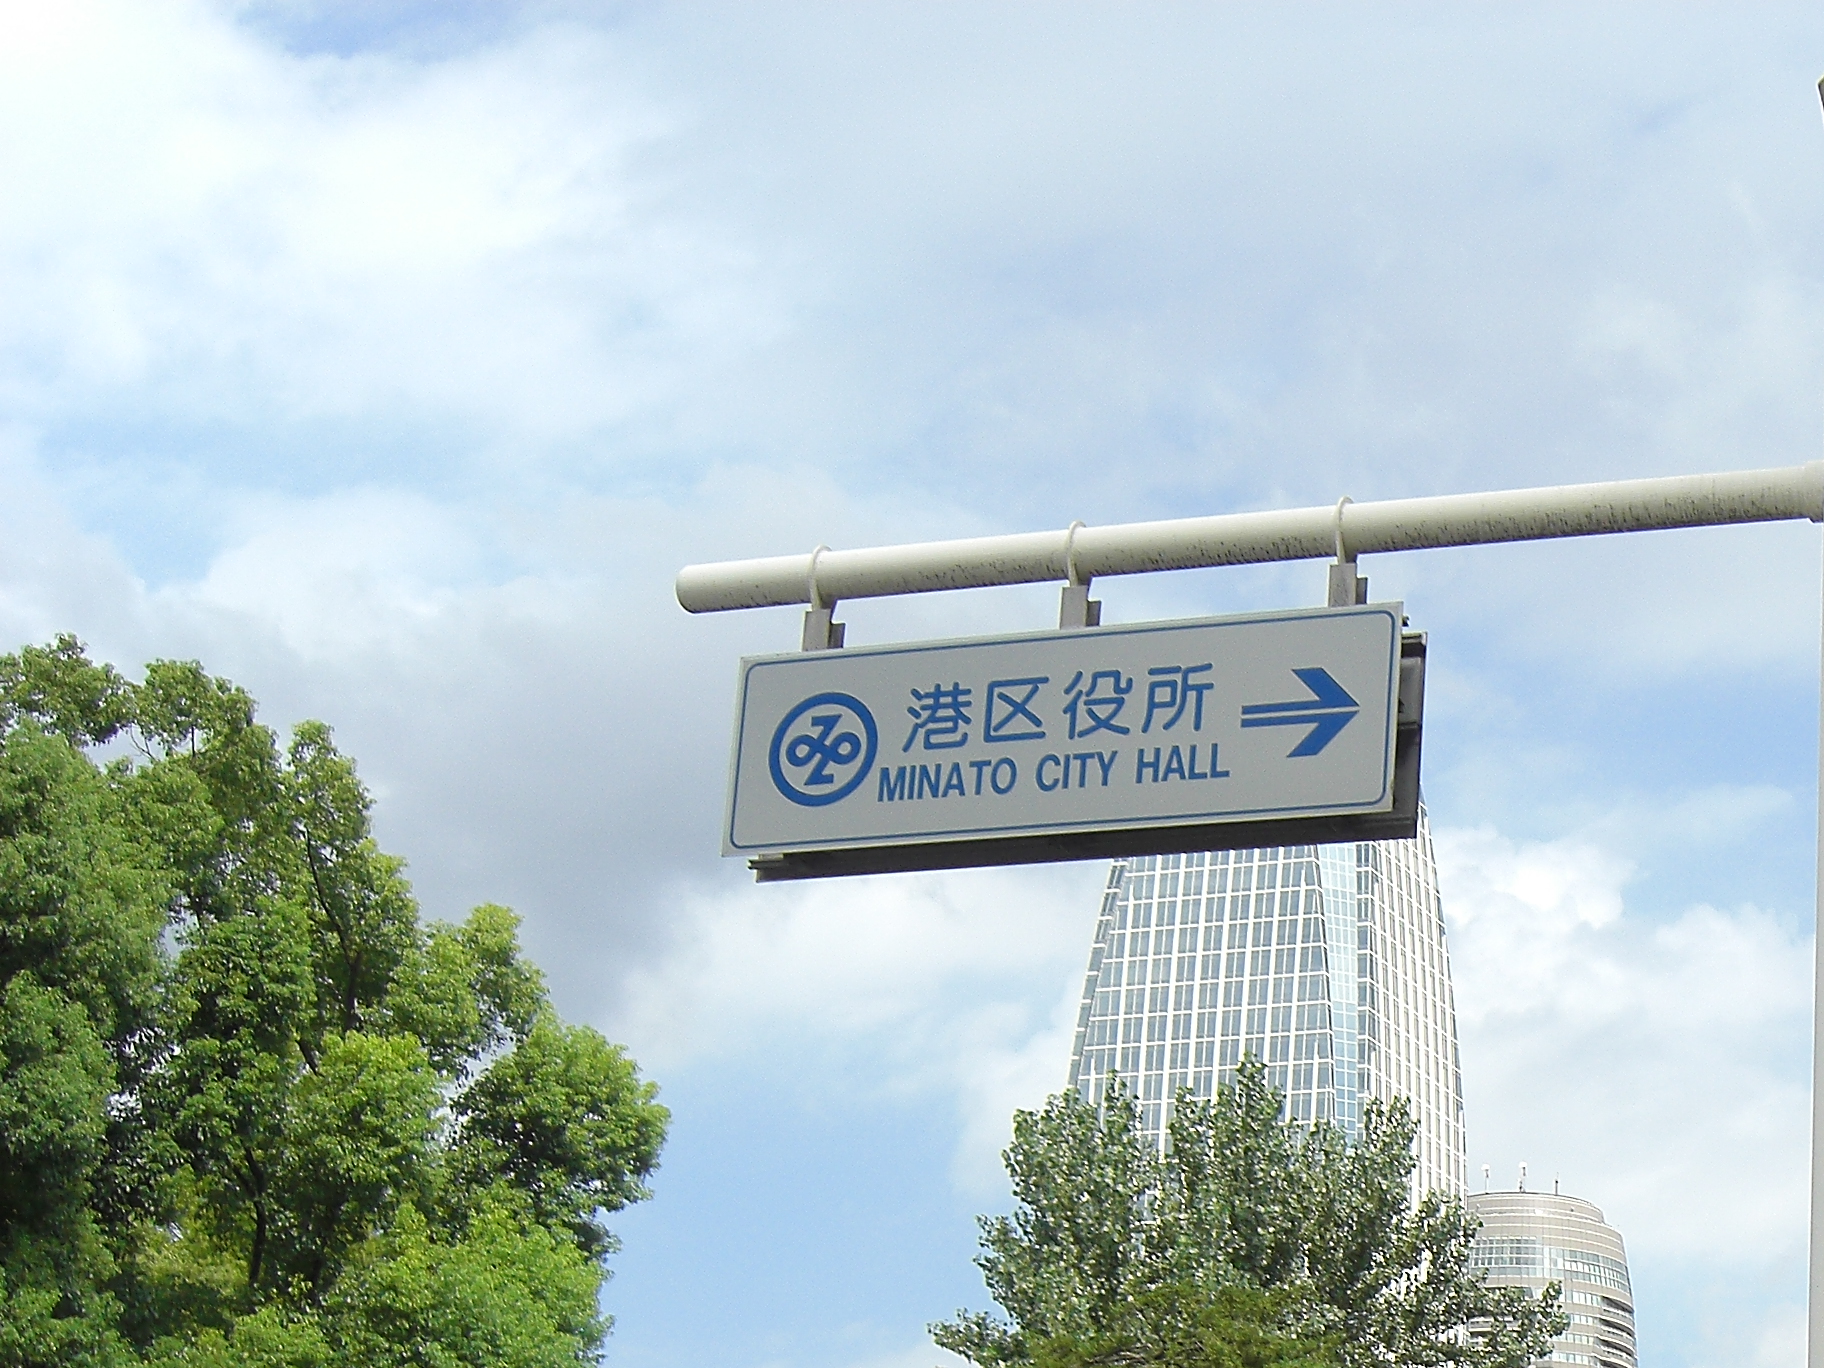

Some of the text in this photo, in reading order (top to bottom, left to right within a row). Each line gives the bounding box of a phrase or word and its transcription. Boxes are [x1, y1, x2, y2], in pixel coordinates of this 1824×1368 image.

[902, 662, 1214, 753] 港区役所
[878, 743, 1230, 802] MINATO CITY HALL
